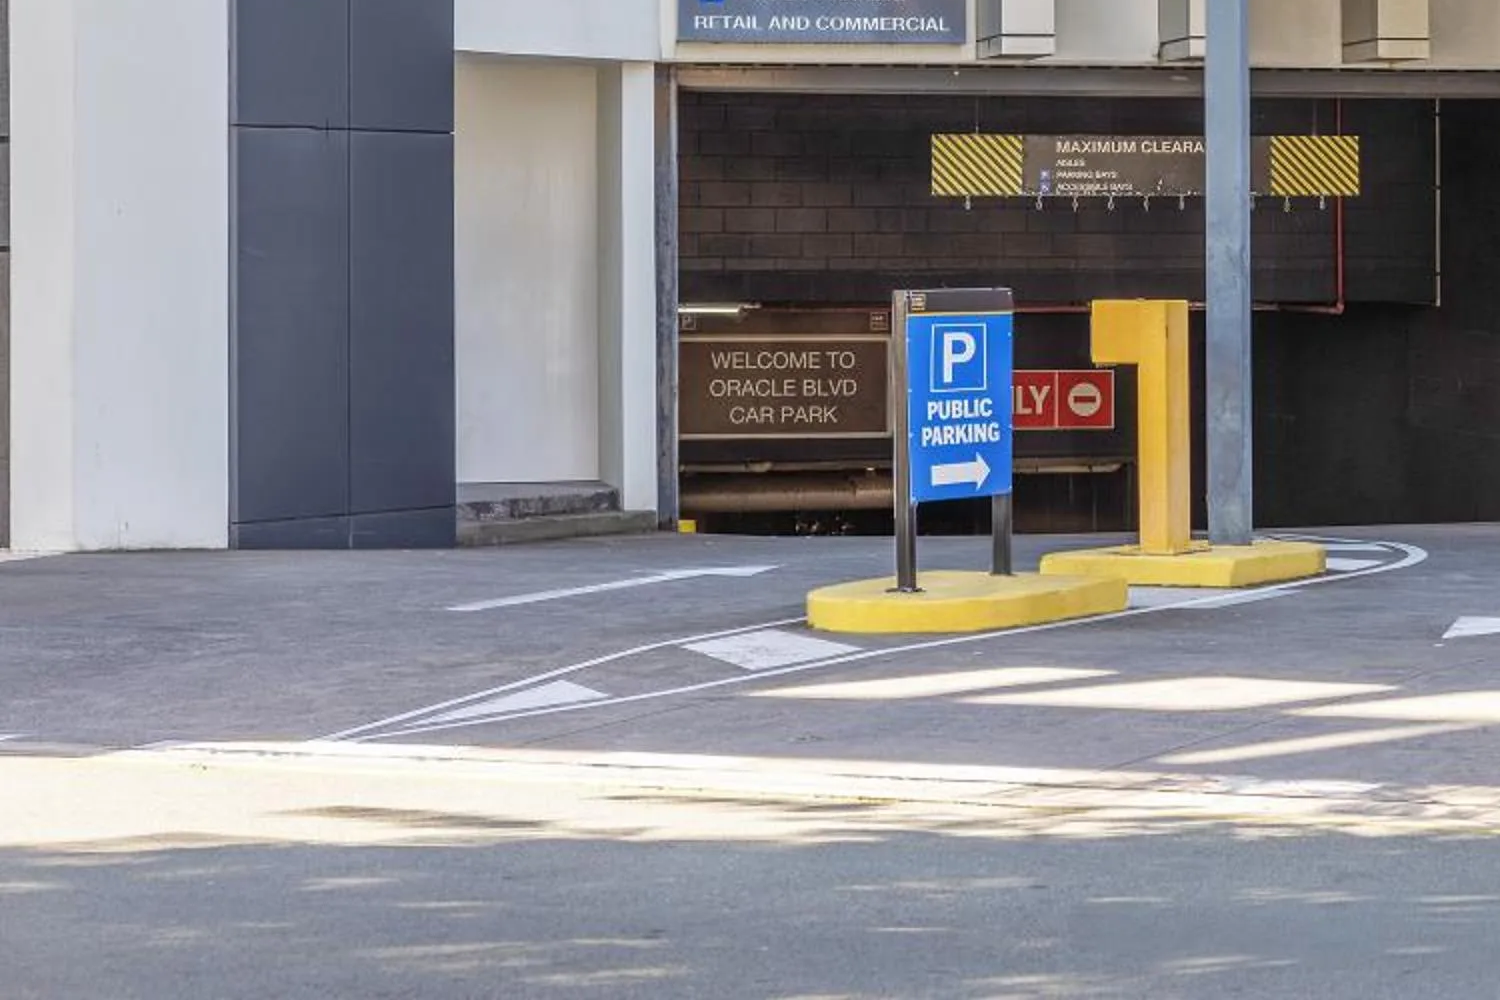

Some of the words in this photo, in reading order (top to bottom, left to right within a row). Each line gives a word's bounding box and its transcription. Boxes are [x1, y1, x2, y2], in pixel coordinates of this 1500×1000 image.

[694, 15, 762, 30] RETAIL
[768, 16, 811, 31] AND
[815, 17, 950, 32] COMMERCIAL
[1055, 140, 1137, 153] MAXIMUM
[1140, 140, 1206, 153] CLEARA
[710, 351, 821, 370] WELCOME
[825, 351, 856, 369] TO
[943, 332, 976, 383] P
[709, 379, 796, 397] ORACLE
[802, 379, 858, 396] BLVD
[927, 398, 993, 421] PUBLIC
[1010, 385, 1051, 415] LY
[729, 406, 775, 424] CAR
[780, 406, 839, 423] PARK
[921, 422, 1001, 447] PARKING
